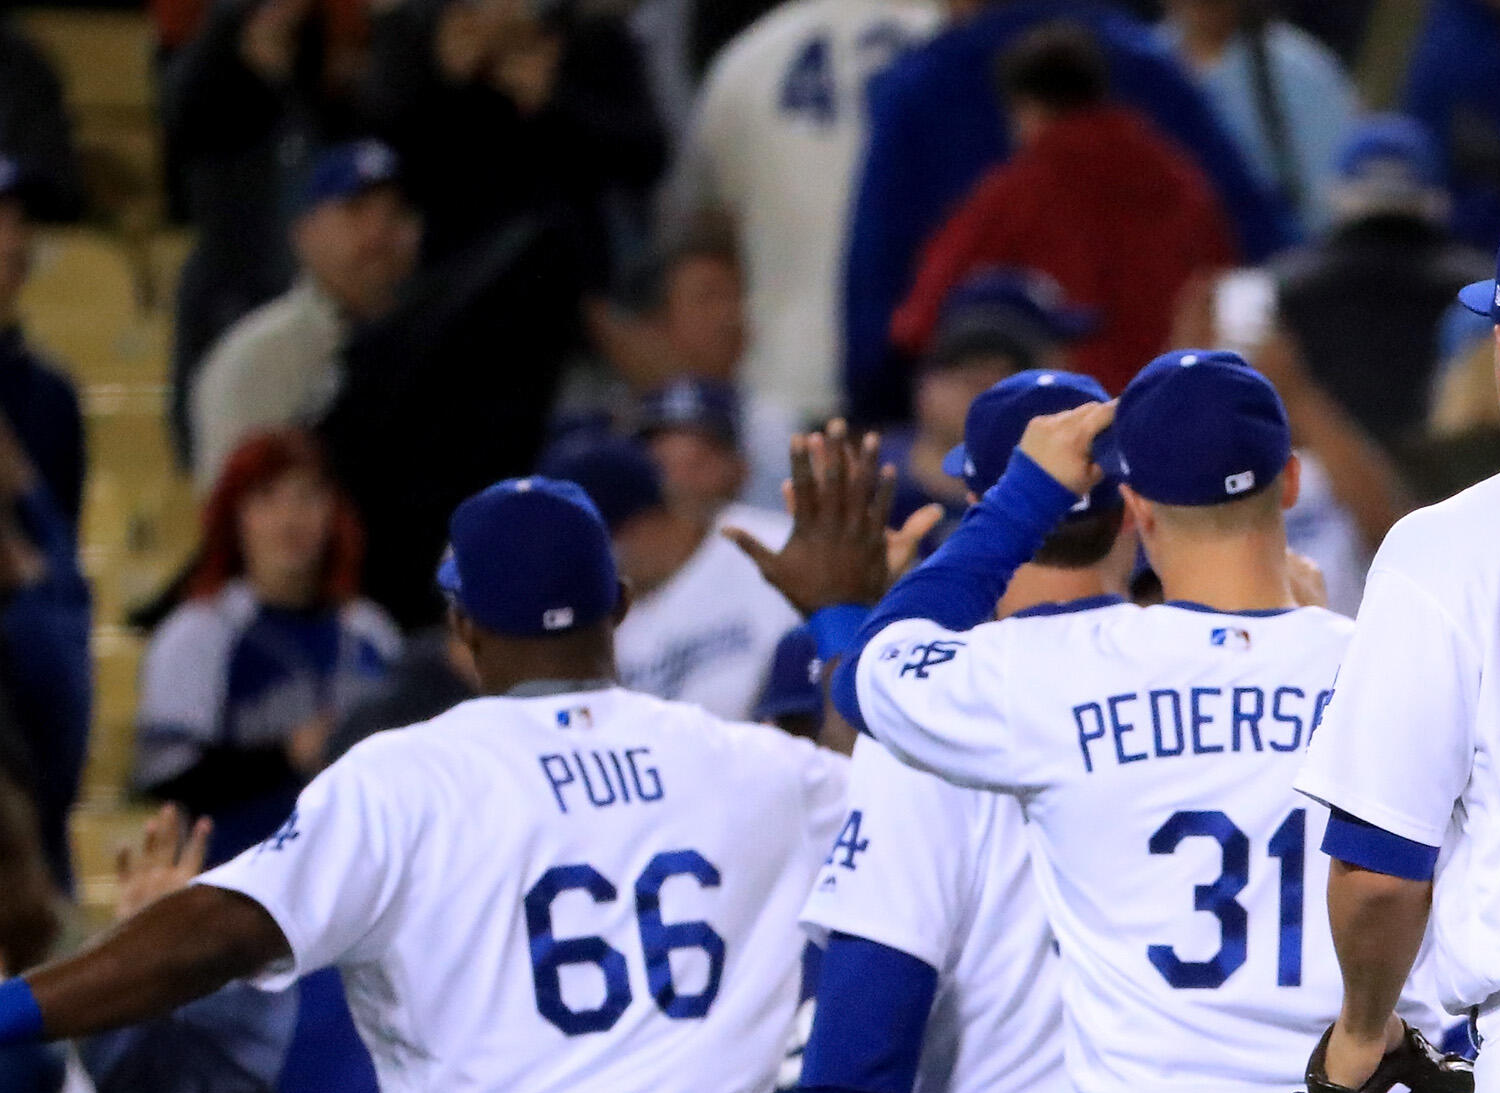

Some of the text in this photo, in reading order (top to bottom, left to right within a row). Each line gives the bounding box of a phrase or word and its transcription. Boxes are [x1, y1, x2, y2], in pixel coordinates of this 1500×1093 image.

[539, 747, 664, 814] PUIG
[824, 810, 870, 871] A
[524, 849, 726, 1038] 66
[1147, 808, 1306, 989] 31
